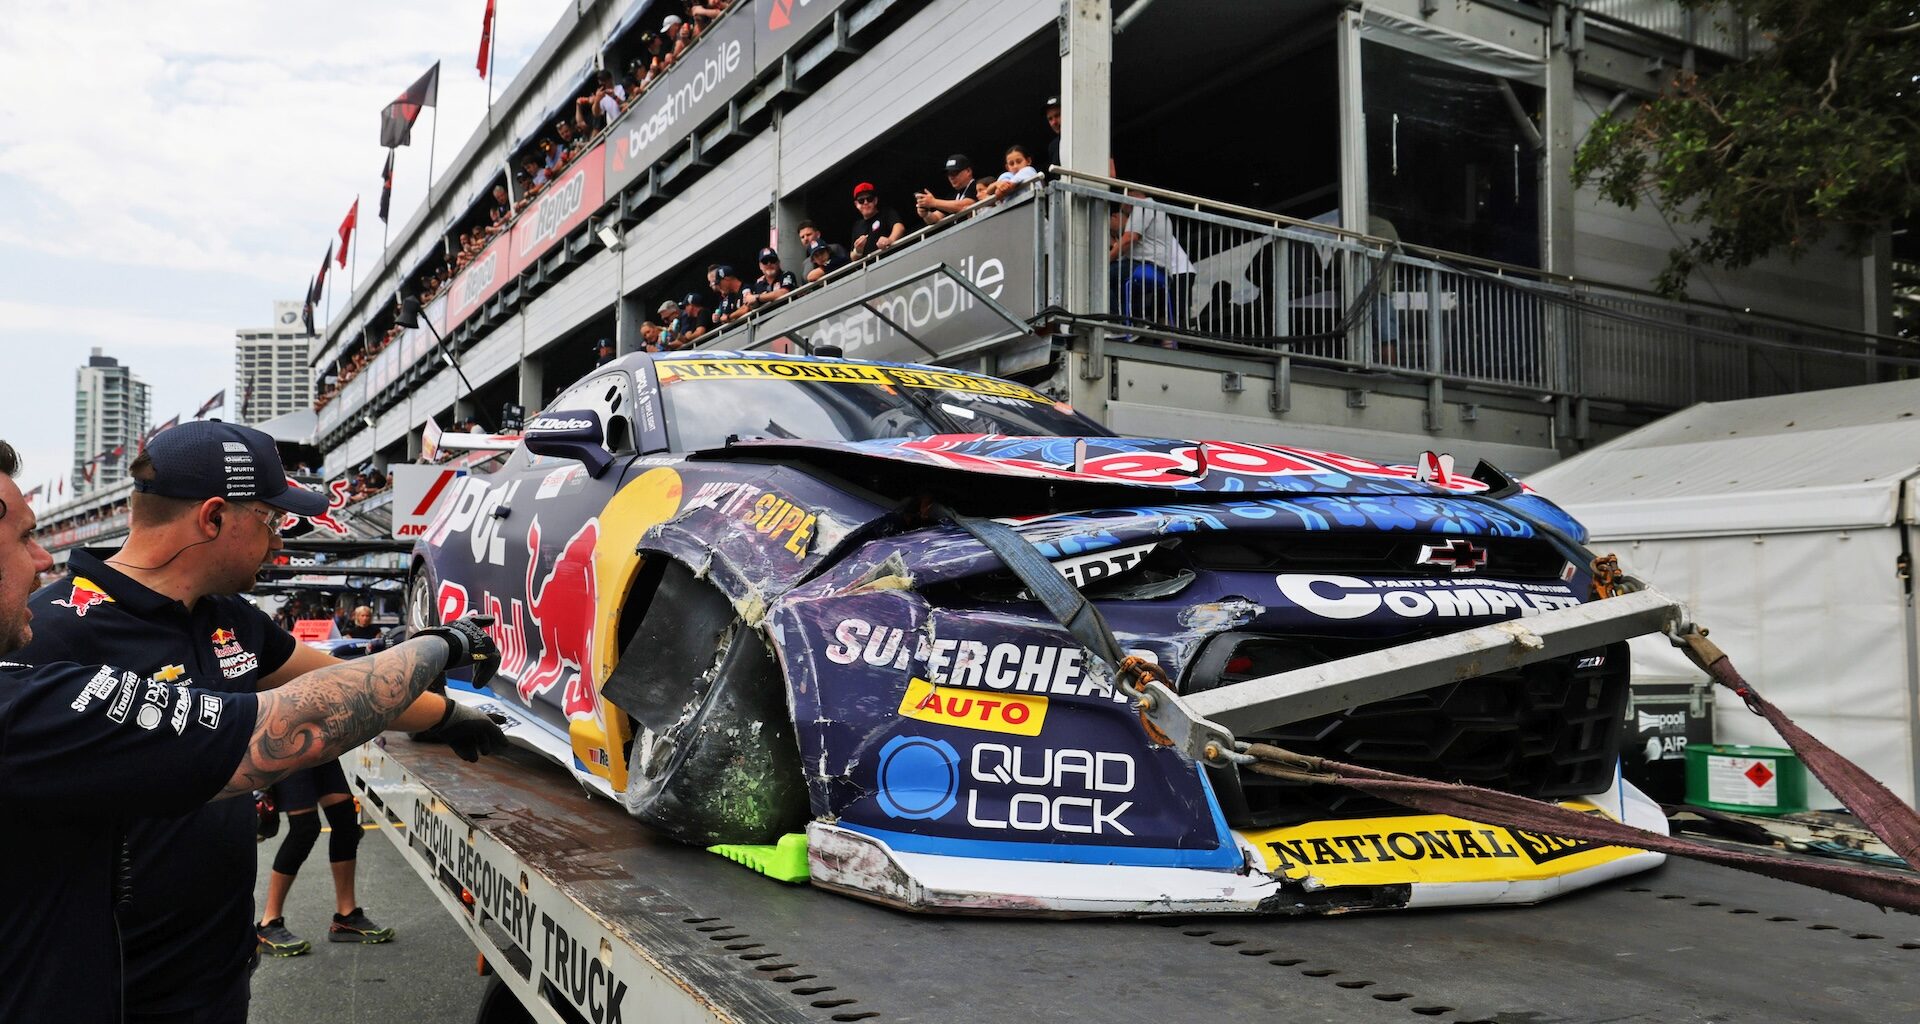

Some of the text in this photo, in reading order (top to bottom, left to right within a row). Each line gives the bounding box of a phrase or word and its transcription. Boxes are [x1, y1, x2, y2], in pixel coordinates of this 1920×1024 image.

[535, 169, 585, 240] Repco
[663, 363, 880, 382] NATIONAL
[528, 417, 593, 430] ACDelco
[397, 524, 427, 535] AM
[290, 556, 316, 567] boo
[1372, 580, 1438, 588] PARTS
[219, 652, 256, 669] AMPOL
[222, 659, 258, 678] RACING
[100, 679, 116, 698] AUTO
[915, 693, 1031, 726] AUTO
[1663, 736, 1687, 752] AIR
[970, 742, 1136, 793] QUAD
[966, 789, 1135, 837] LOCK
[1267, 830, 1519, 869] NATIONAL
[414, 798, 628, 1024] OFFICIAL RECOVERY TRUCK
